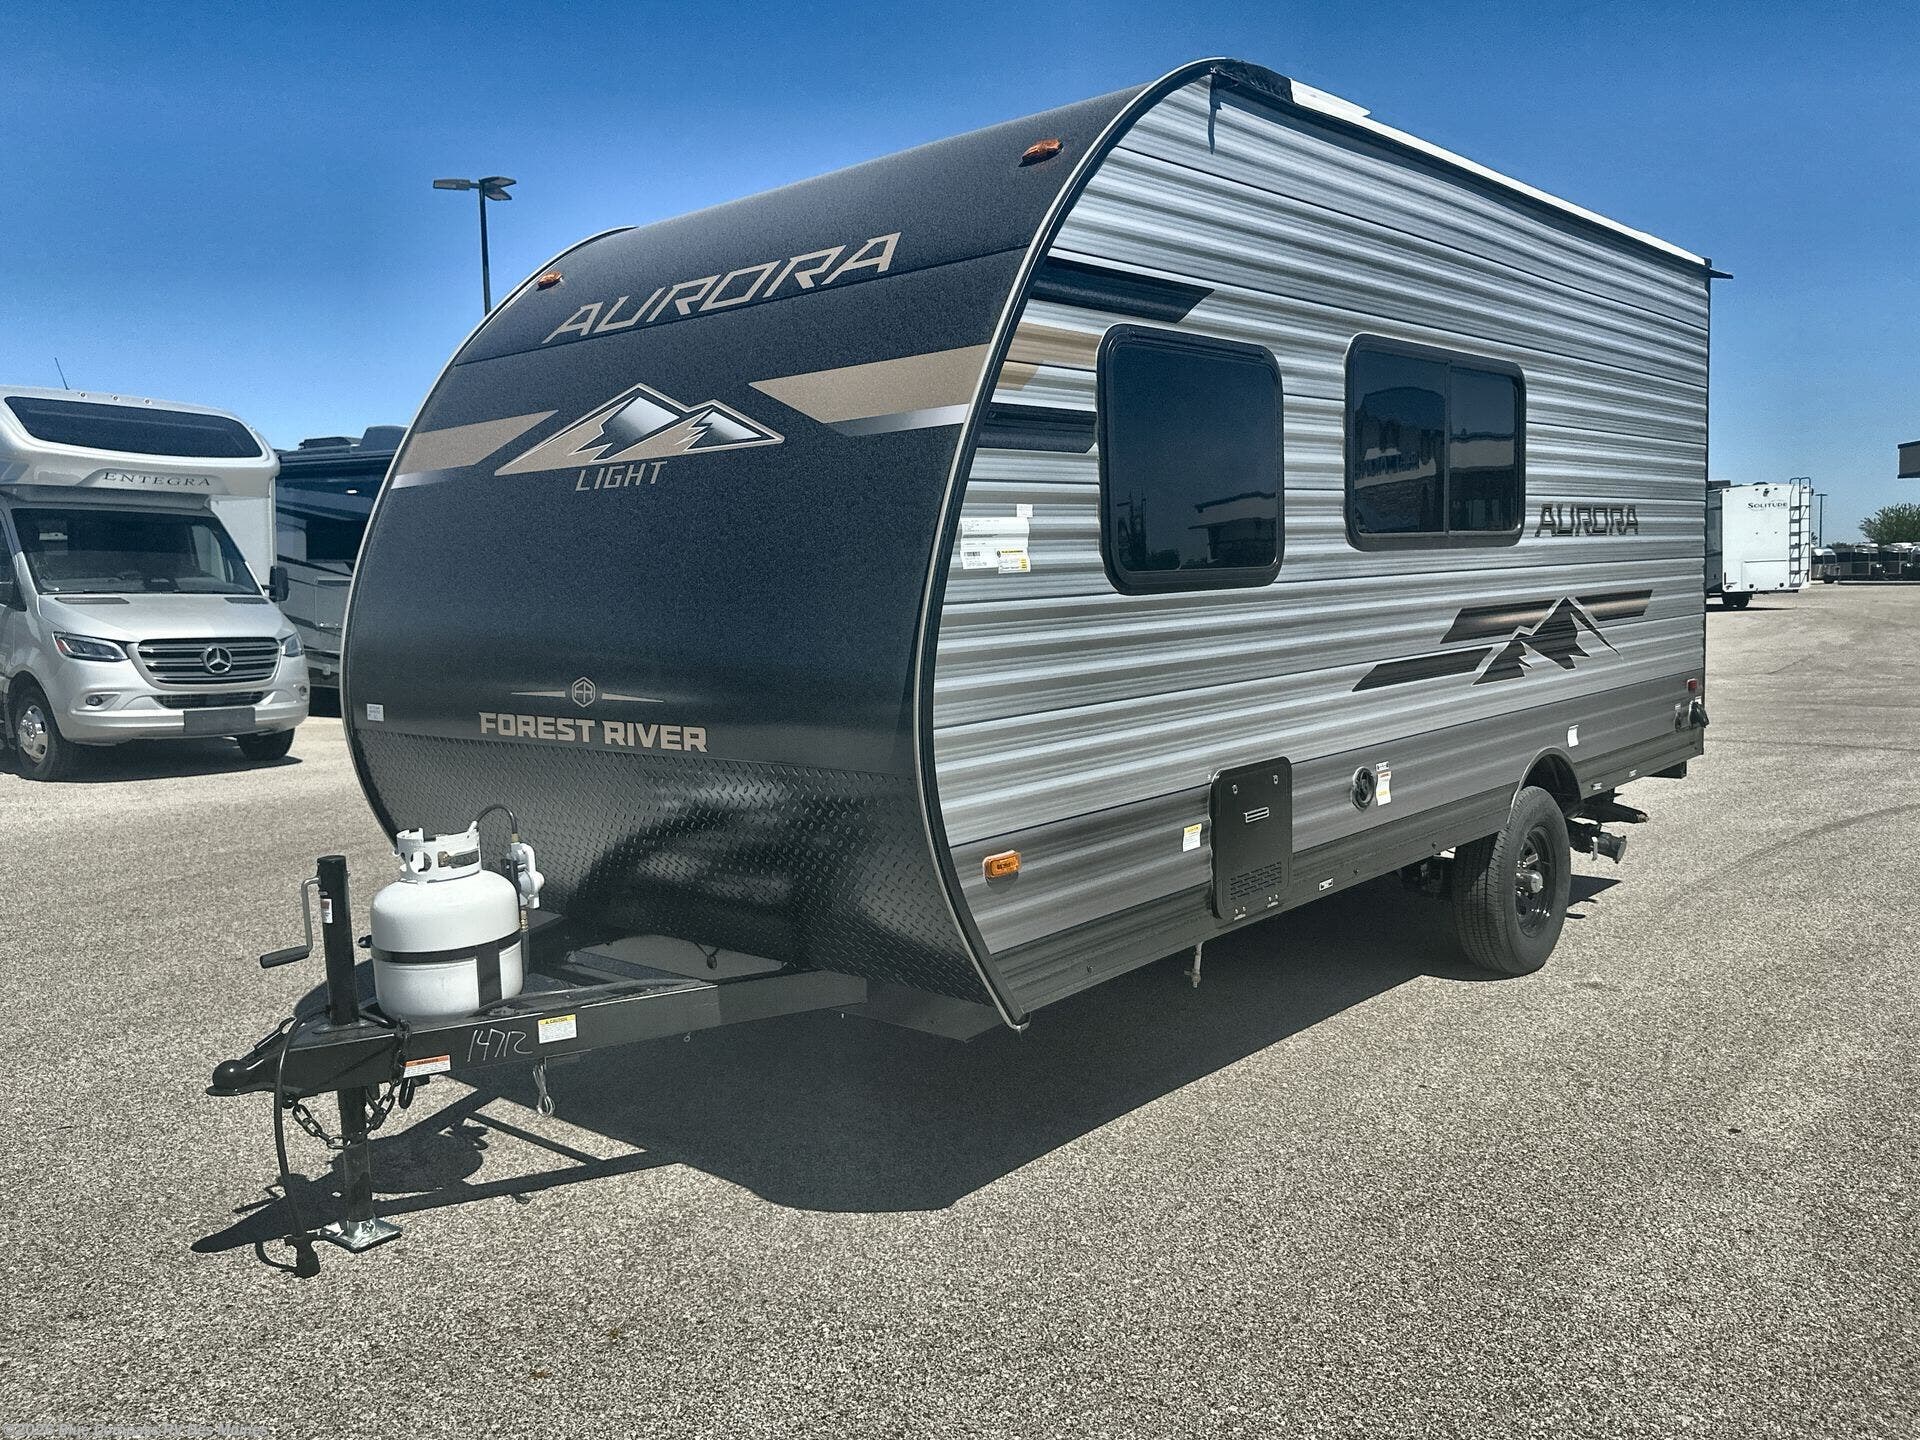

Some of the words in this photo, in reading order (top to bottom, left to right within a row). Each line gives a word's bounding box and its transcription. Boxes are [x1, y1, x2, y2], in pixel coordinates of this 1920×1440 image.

[541, 232, 901, 344] AURORA
[104, 472, 210, 486] ENTEGRA
[574, 460, 668, 493] LIGHT
[1534, 503, 1639, 538] AURORA
[478, 711, 596, 743] FOREST
[602, 720, 708, 753] RIVER
